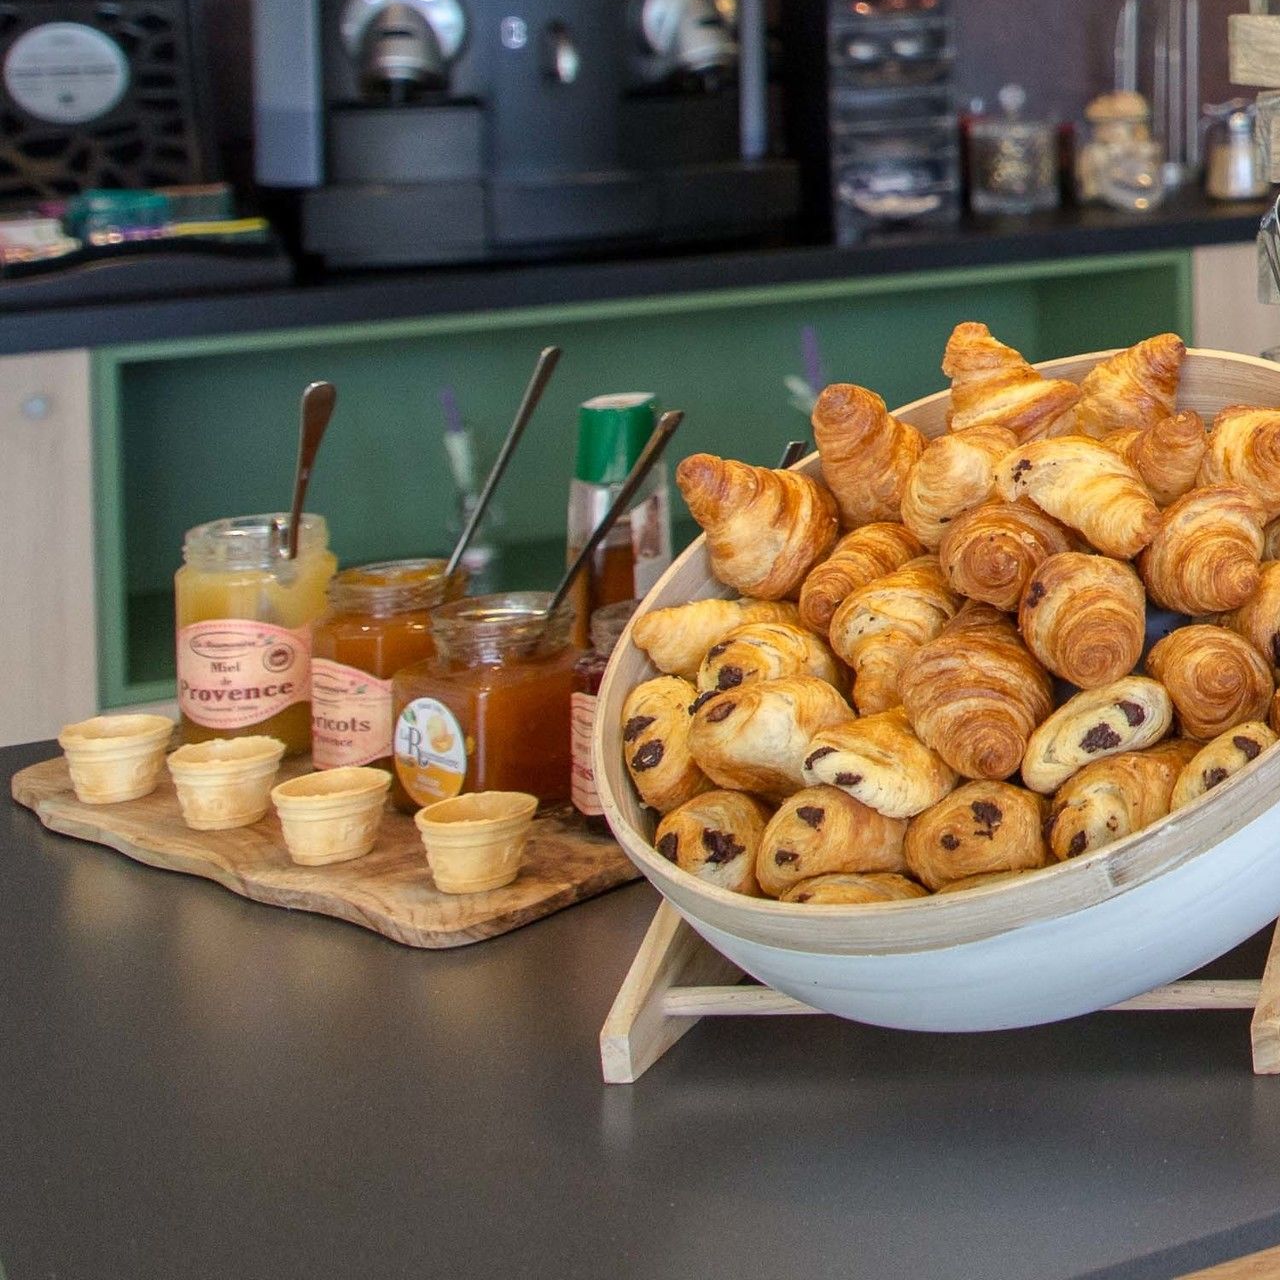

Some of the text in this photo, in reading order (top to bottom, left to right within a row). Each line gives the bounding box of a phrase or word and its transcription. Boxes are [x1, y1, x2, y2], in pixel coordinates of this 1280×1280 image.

[210, 661, 241, 673] Miel
[179, 678, 294, 702] Provence
[312, 712, 372, 733] ricots
